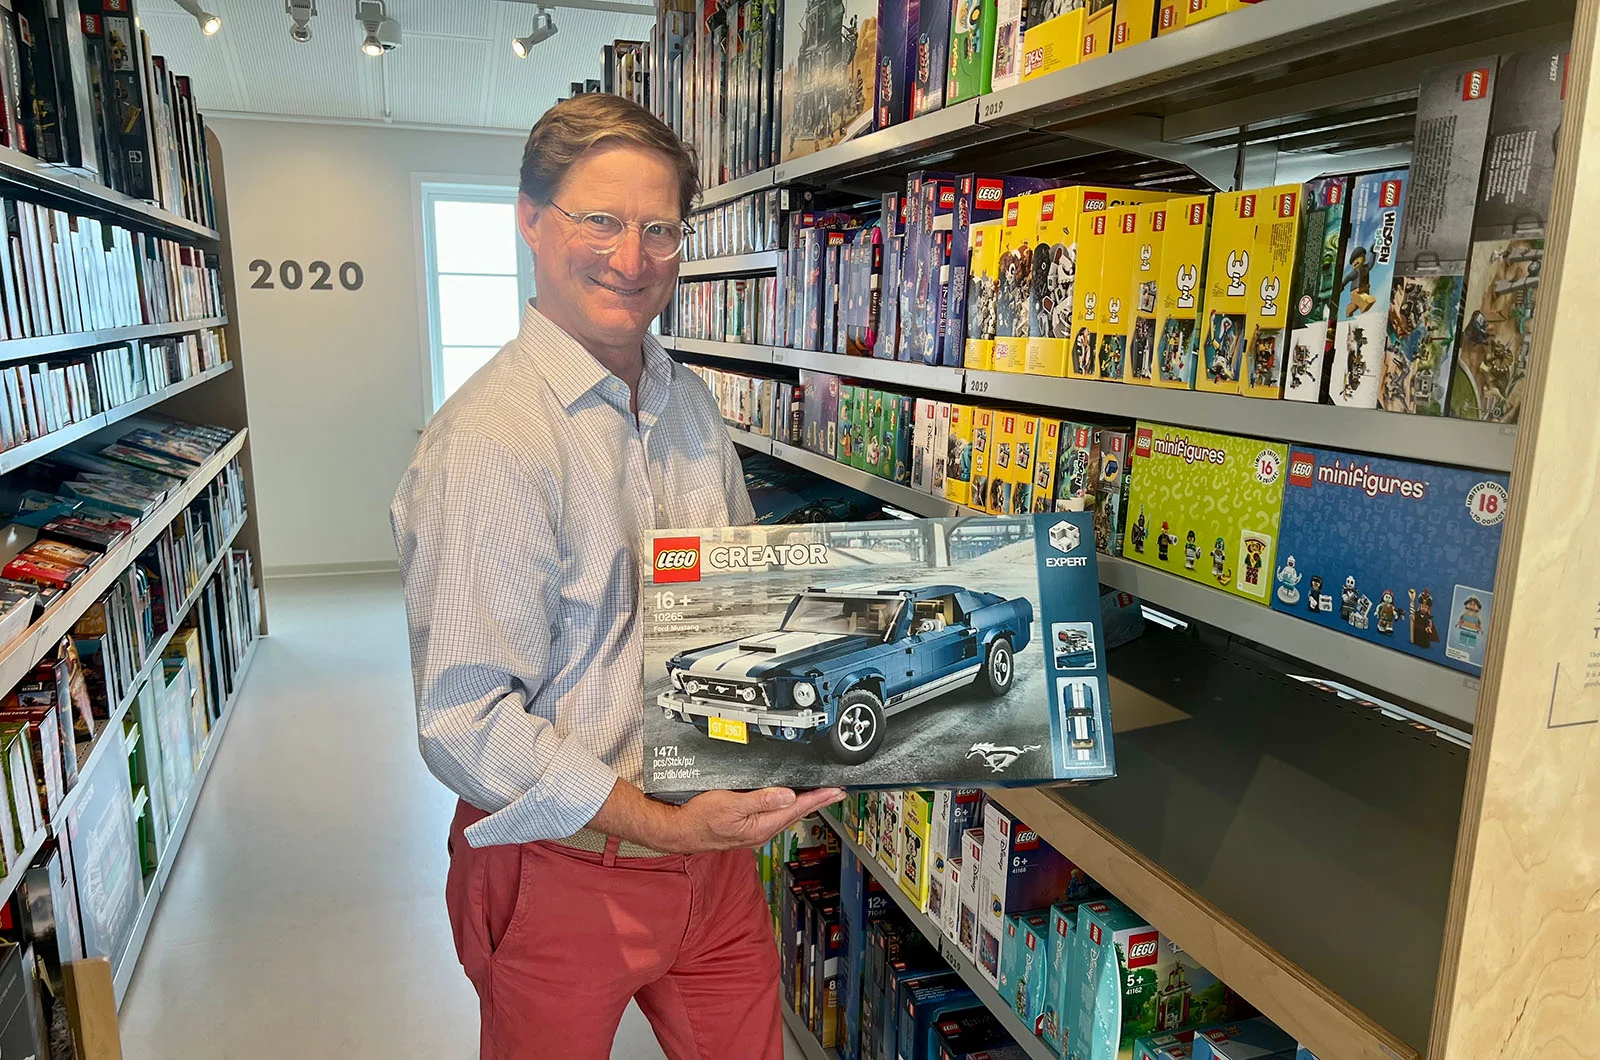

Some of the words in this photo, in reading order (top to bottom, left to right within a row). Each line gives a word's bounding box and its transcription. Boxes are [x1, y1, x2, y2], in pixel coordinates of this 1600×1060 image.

[1470, 71, 1482, 98] LEGO
[984, 101, 1004, 117] 2019
[978, 188, 1002, 200] LEGO
[1385, 182, 1396, 206] LEGO
[1085, 200, 1104, 210] LEGO
[1244, 197, 1252, 216] LEGO
[1284, 196, 1292, 216] LEGO
[248, 259, 364, 291] 2020
[970, 380, 988, 392] 2019
[1138, 436, 1151, 449] LEGO
[1154, 433, 1226, 465] minifigures
[1261, 461, 1273, 476] 16
[1292, 461, 1313, 477] LEGO
[1317, 460, 1426, 500] minifigures
[1466, 483, 1485, 506] LIMITED
[1479, 494, 1498, 514] 18
[656, 550, 698, 570] LEGO
[709, 543, 828, 568] CREATOR
[1046, 556, 1087, 568] EXPERT
[654, 612, 684, 622] 10265
[670, 624, 700, 632] Mustang
[712, 722, 722, 733] GT
[724, 724, 743, 736] 1967
[654, 746, 678, 758] 1471
[954, 808, 968, 818] 6+
[1016, 832, 1038, 843] LEGO
[1012, 857, 1028, 867] 6+
[868, 897, 888, 910] 12+
[1130, 942, 1157, 958] LEGO
[1127, 974, 1144, 987] 5+
[1126, 986, 1142, 996] 41162
